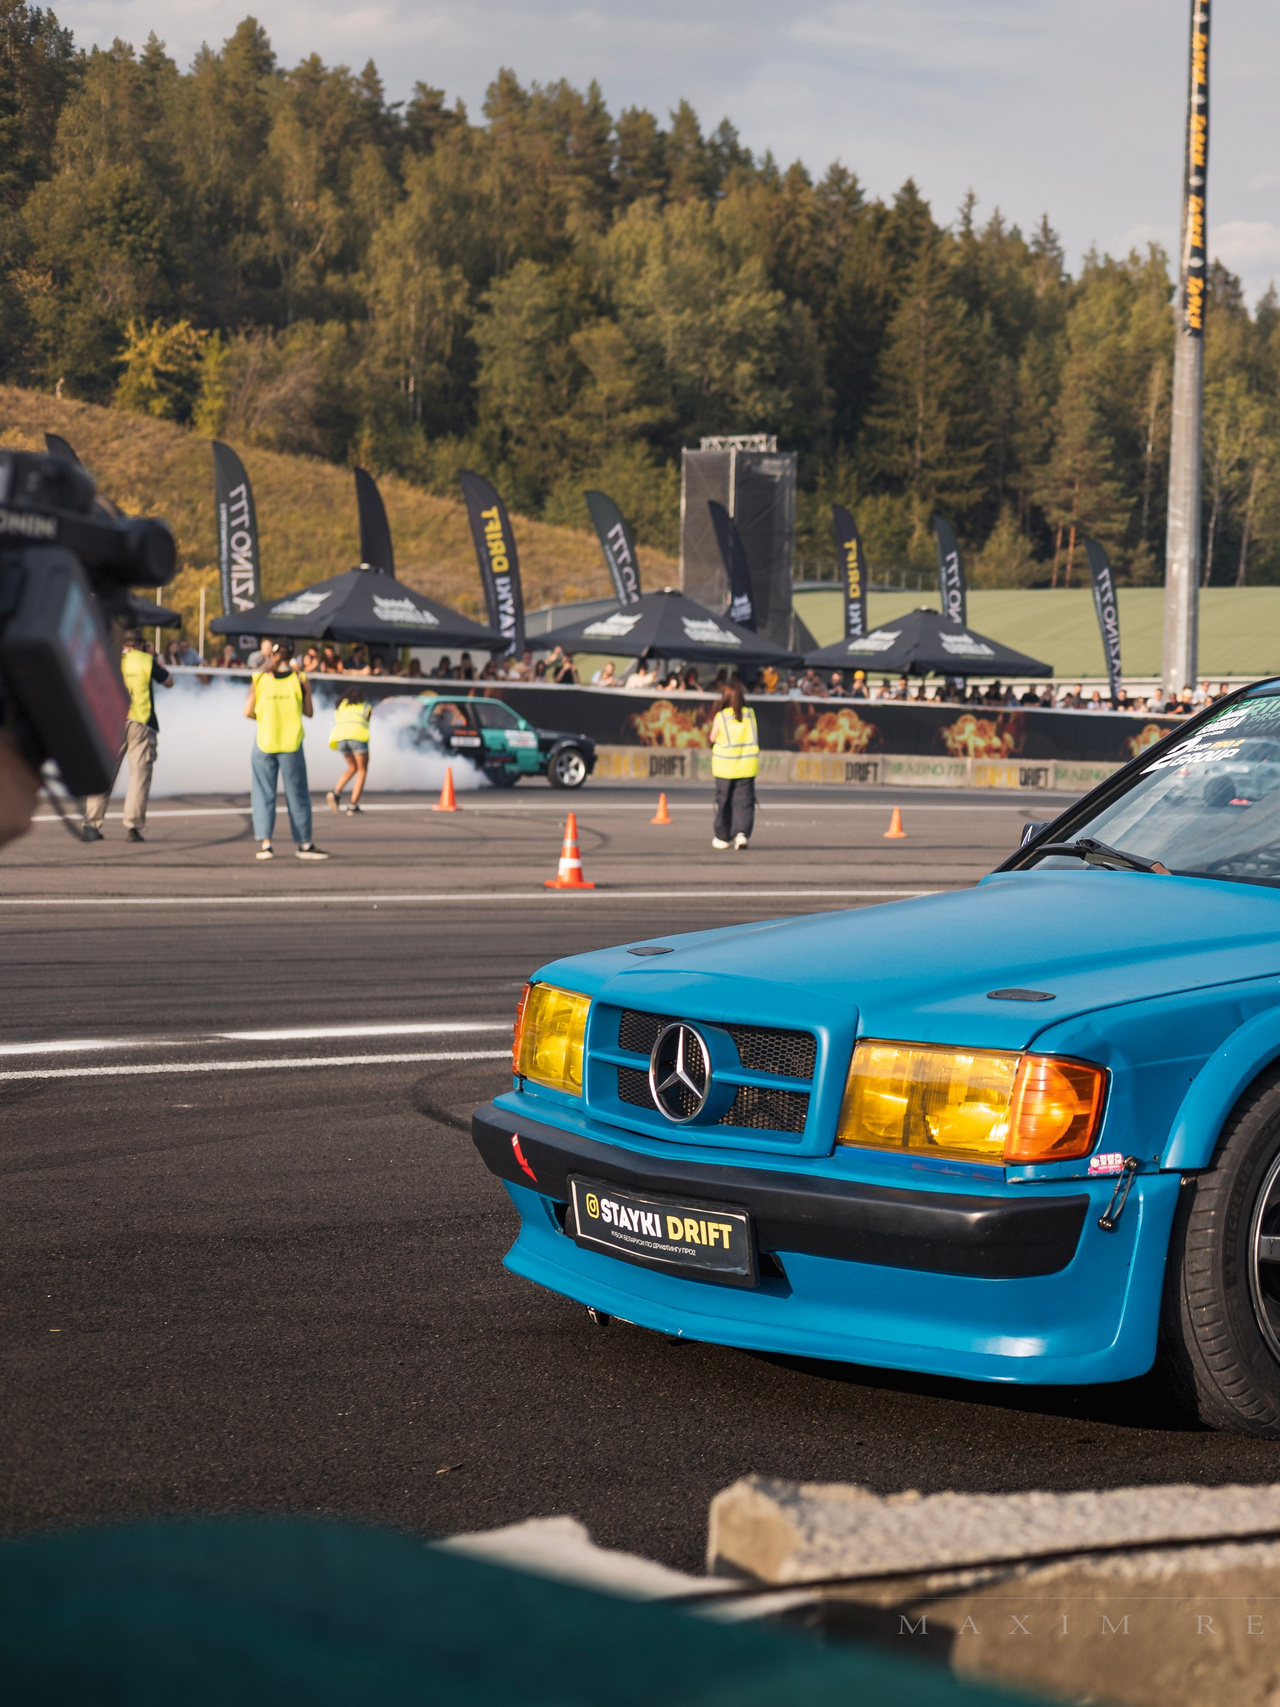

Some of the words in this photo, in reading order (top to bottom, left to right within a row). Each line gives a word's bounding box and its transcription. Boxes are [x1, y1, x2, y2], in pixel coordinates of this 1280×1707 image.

[649, 755, 686, 776] DRIFT
[1169, 748, 1241, 767] GROUP
[845, 761, 879, 781] DRIFT
[600, 1198, 662, 1238] STAYKI
[666, 1215, 733, 1249] DRIFT
[645, 1240, 653, 1248] ПО
